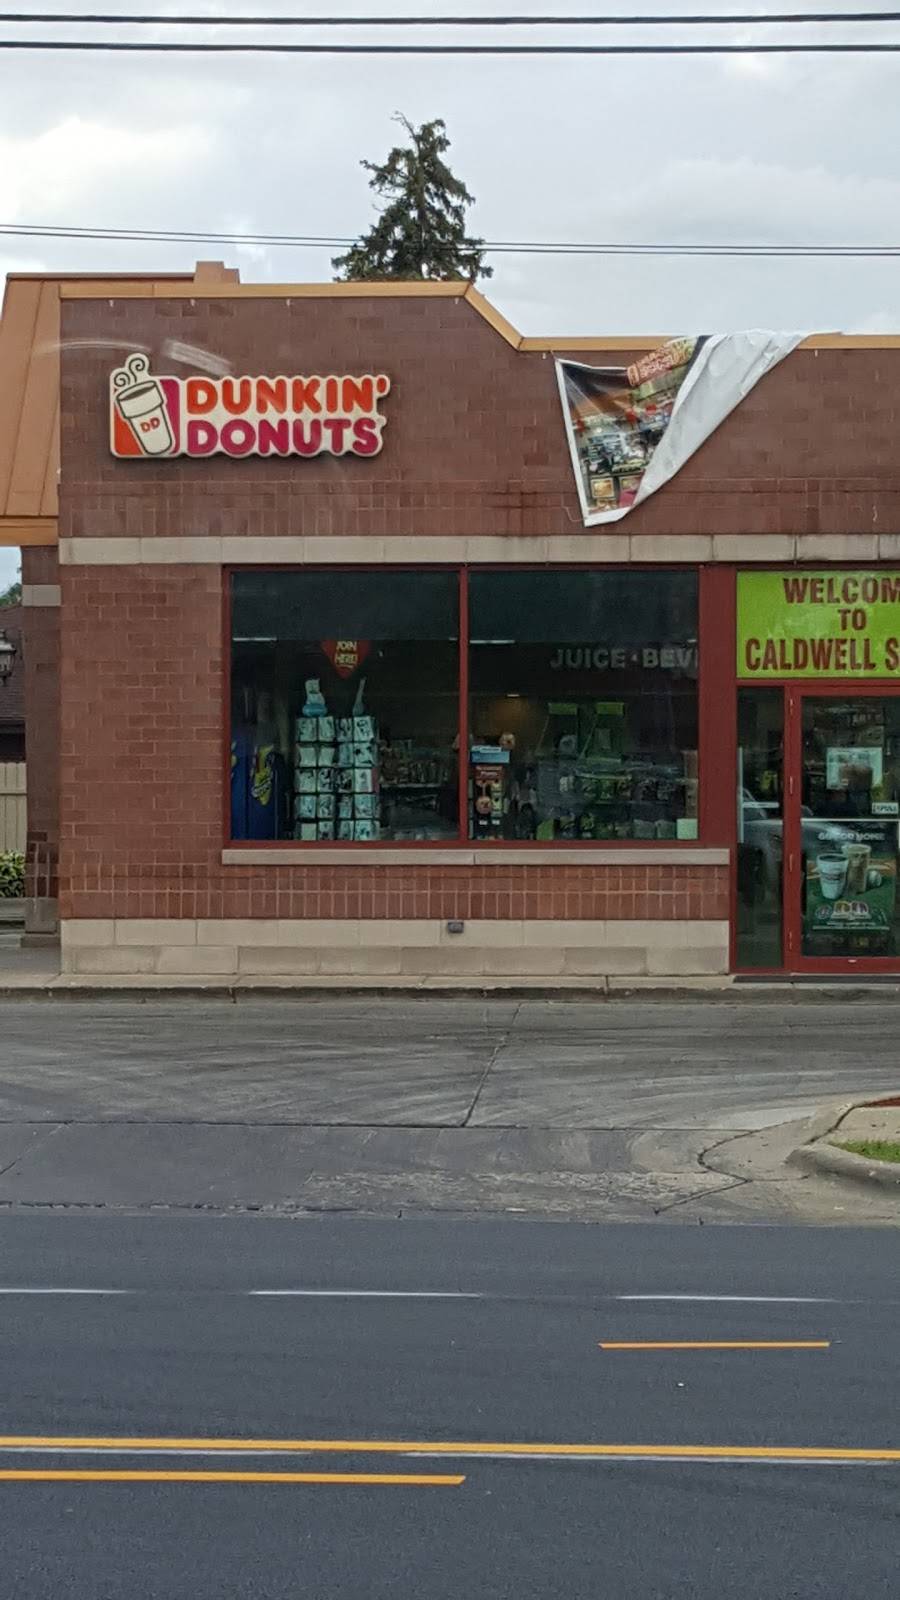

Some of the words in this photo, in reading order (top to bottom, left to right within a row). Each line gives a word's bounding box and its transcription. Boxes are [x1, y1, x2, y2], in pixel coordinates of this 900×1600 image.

[186, 378, 389, 415] DUNKIN'
[140, 417, 160, 433] DD
[186, 417, 379, 456] DONUTS
[837, 608, 867, 631] TO
[550, 648, 626, 669] JUICE
[641, 648, 698, 669] BEV
[745, 637, 876, 671] CALDWELL
